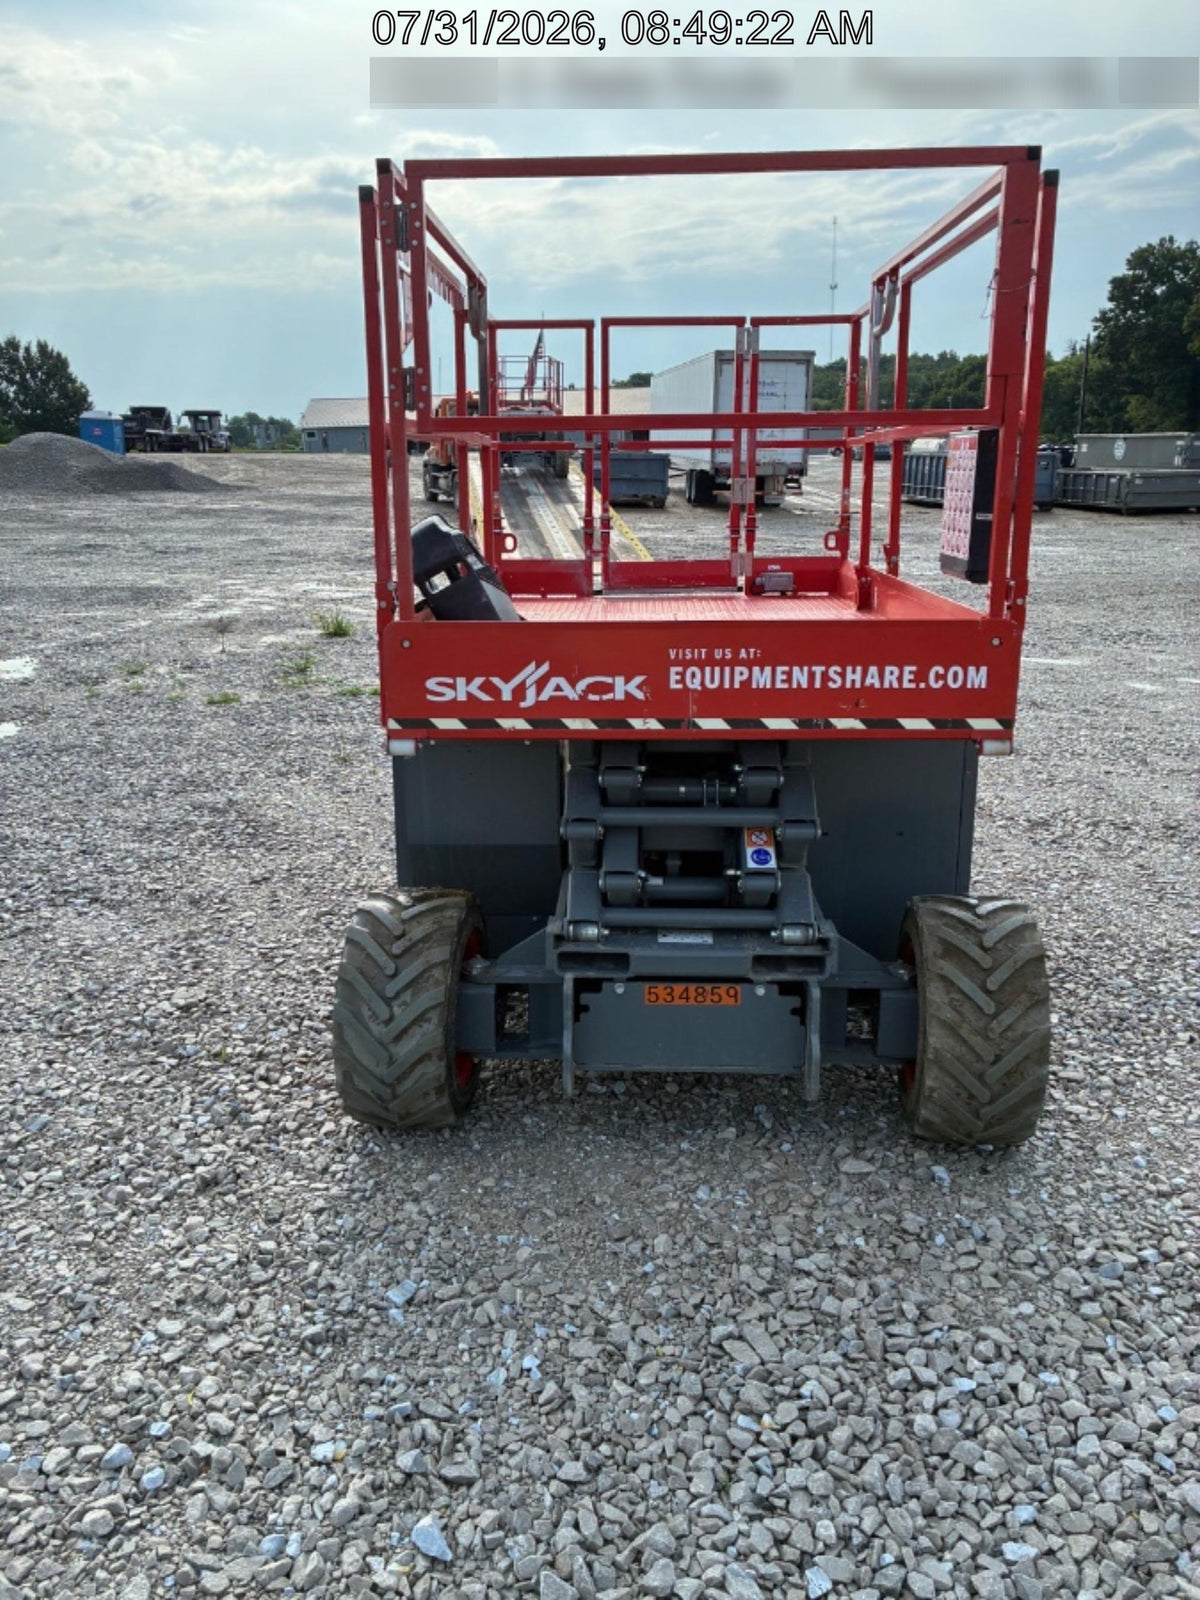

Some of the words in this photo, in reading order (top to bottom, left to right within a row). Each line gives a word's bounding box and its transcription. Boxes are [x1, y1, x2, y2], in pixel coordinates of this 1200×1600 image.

[669, 648, 708, 660] VISIT
[714, 648, 732, 660] US
[739, 648, 761, 660] AT:
[425, 660, 648, 708] SKYJACK
[668, 665, 989, 690] EQUIPMENTSHARE.COM
[647, 985, 739, 1004] 534859
